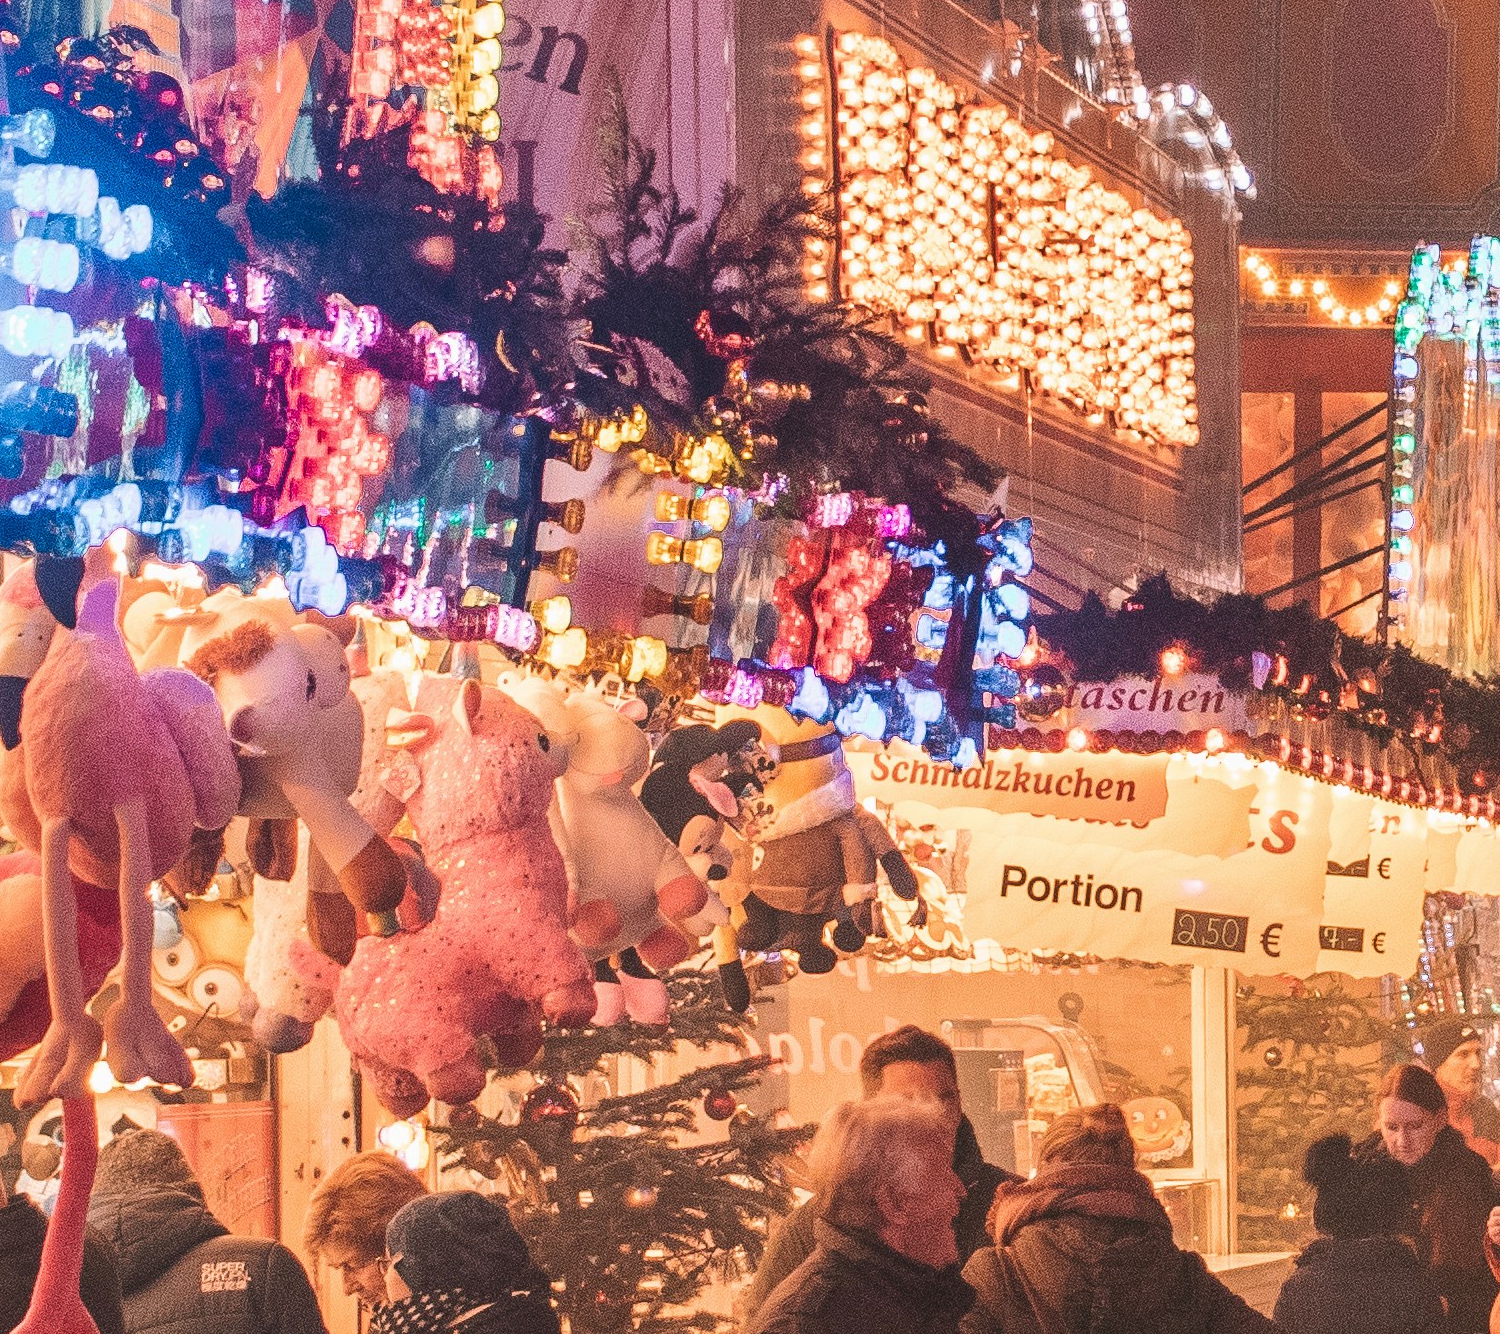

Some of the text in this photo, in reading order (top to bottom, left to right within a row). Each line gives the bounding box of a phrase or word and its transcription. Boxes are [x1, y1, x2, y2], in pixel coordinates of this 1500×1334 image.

[869, 752, 1137, 803] Schmalzkuchen
[1000, 864, 1143, 914] Portion
[1260, 922, 1284, 958] €
[1372, 931, 1387, 954] €
[201, 1261, 246, 1271] SUPER
